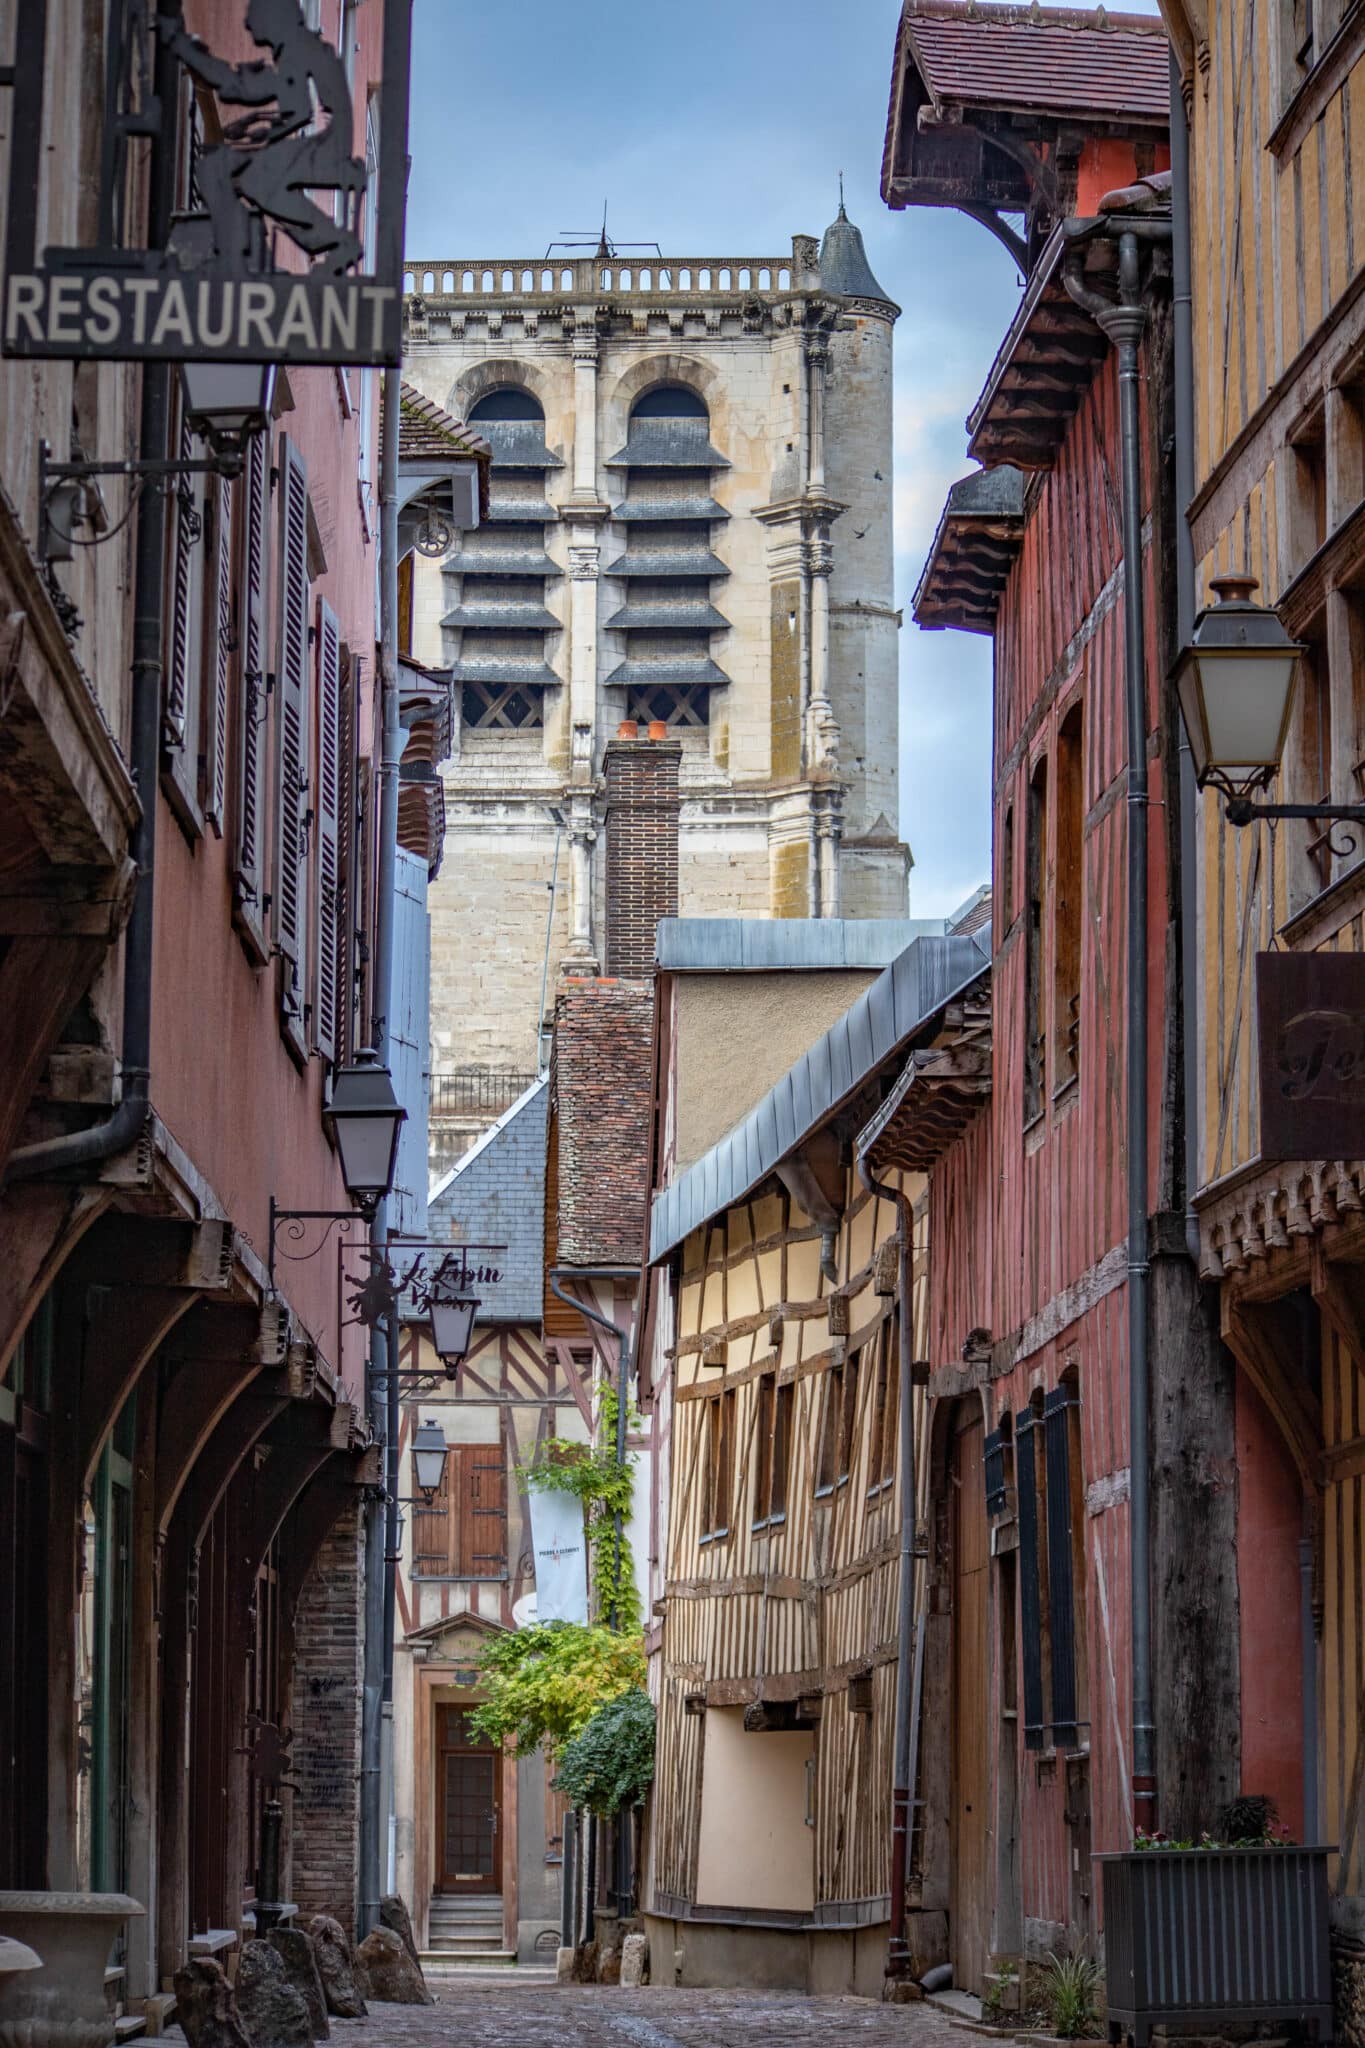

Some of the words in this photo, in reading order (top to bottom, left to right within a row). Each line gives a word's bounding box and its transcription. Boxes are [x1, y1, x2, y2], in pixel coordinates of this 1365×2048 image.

[6, 275, 396, 351] RESTAURANT
[401, 1252, 428, 1288] Le
[429, 1252, 504, 1291] Lapin
